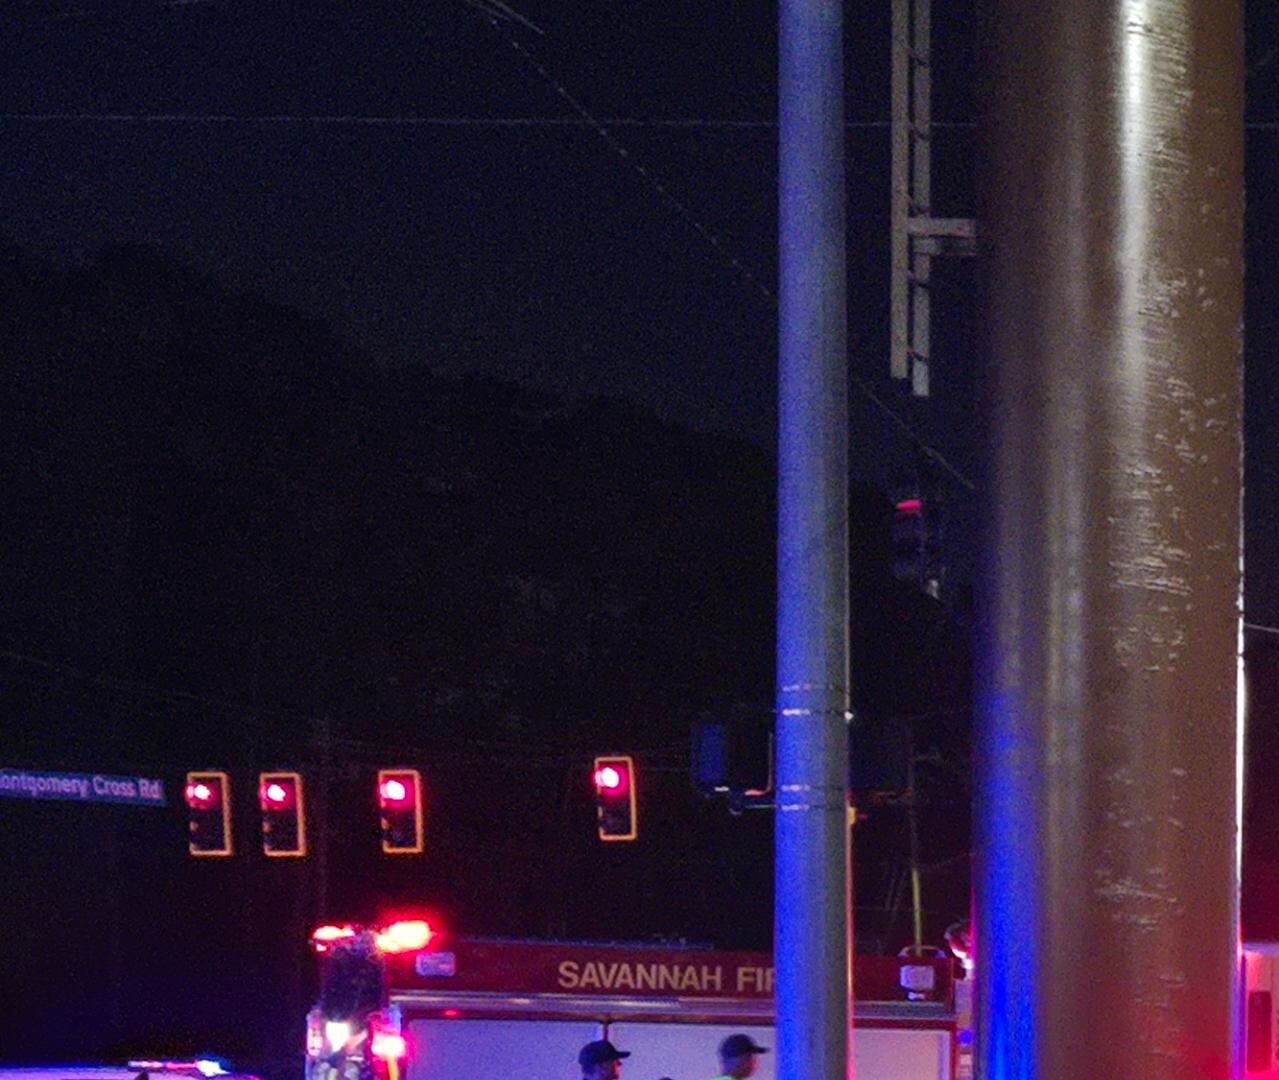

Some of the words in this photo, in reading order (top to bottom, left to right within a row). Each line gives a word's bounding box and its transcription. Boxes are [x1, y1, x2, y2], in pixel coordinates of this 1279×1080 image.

[0, 774, 90, 798] ontgomery
[92, 776, 136, 797] Cross
[138, 778, 162, 799] Rd
[558, 961, 722, 991] SAVANNAH
